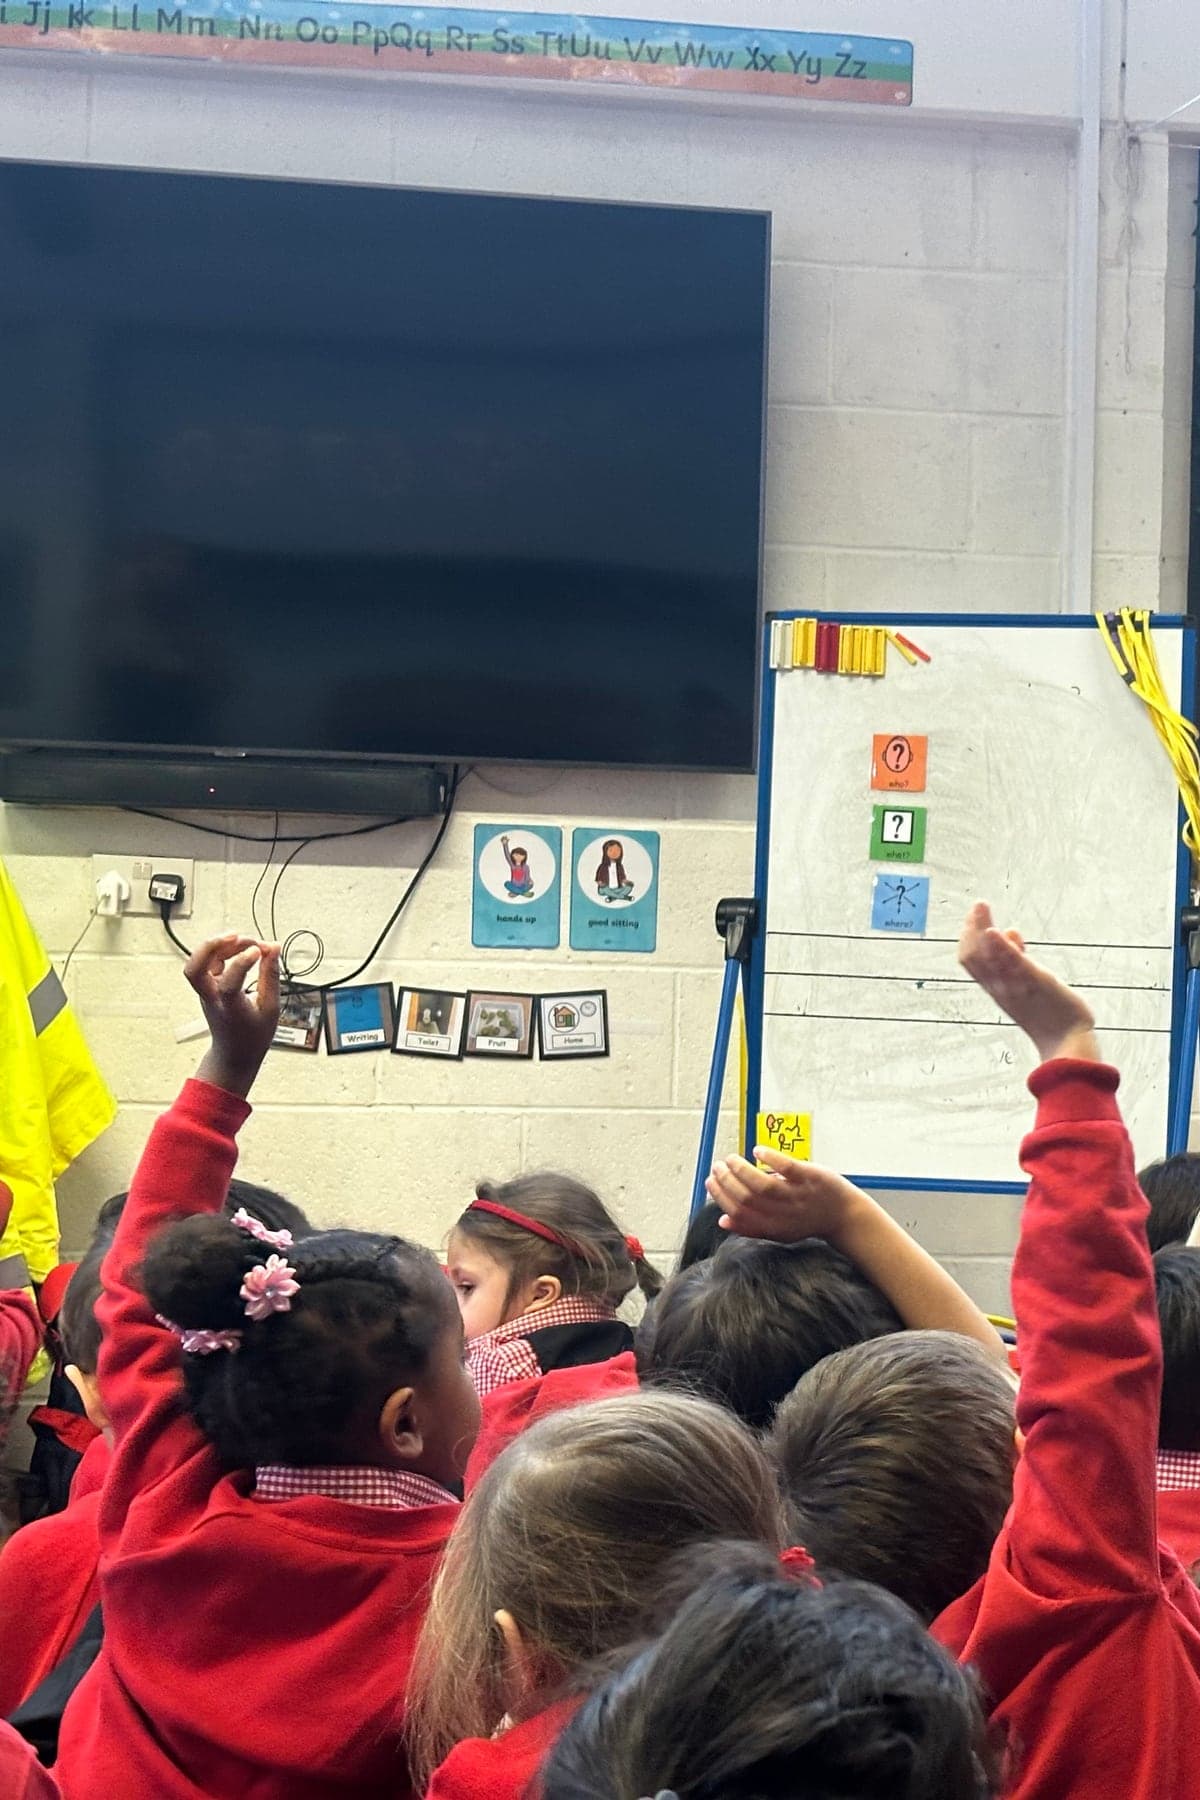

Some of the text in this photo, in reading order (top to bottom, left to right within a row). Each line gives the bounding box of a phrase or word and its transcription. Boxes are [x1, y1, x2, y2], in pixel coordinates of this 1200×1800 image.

[157, 8, 218, 36] Mm
[240, 14, 284, 41] Nn
[296, 17, 339, 44] Oo
[446, 25, 480, 51] Rr
[491, 28, 525, 55] Ss
[624, 37, 664, 63] Vv
[674, 40, 734, 69] Ww
[744, 46, 777, 73] Xx
[787, 49, 822, 84] Yy
[834, 52, 867, 79] Zz
[525, 915, 537, 925] up
[587, 917, 640, 930] good sitting
[347, 1033, 379, 1043] Writing
[417, 1037, 440, 1046] Toilet
[488, 1039, 507, 1047] Fruit
